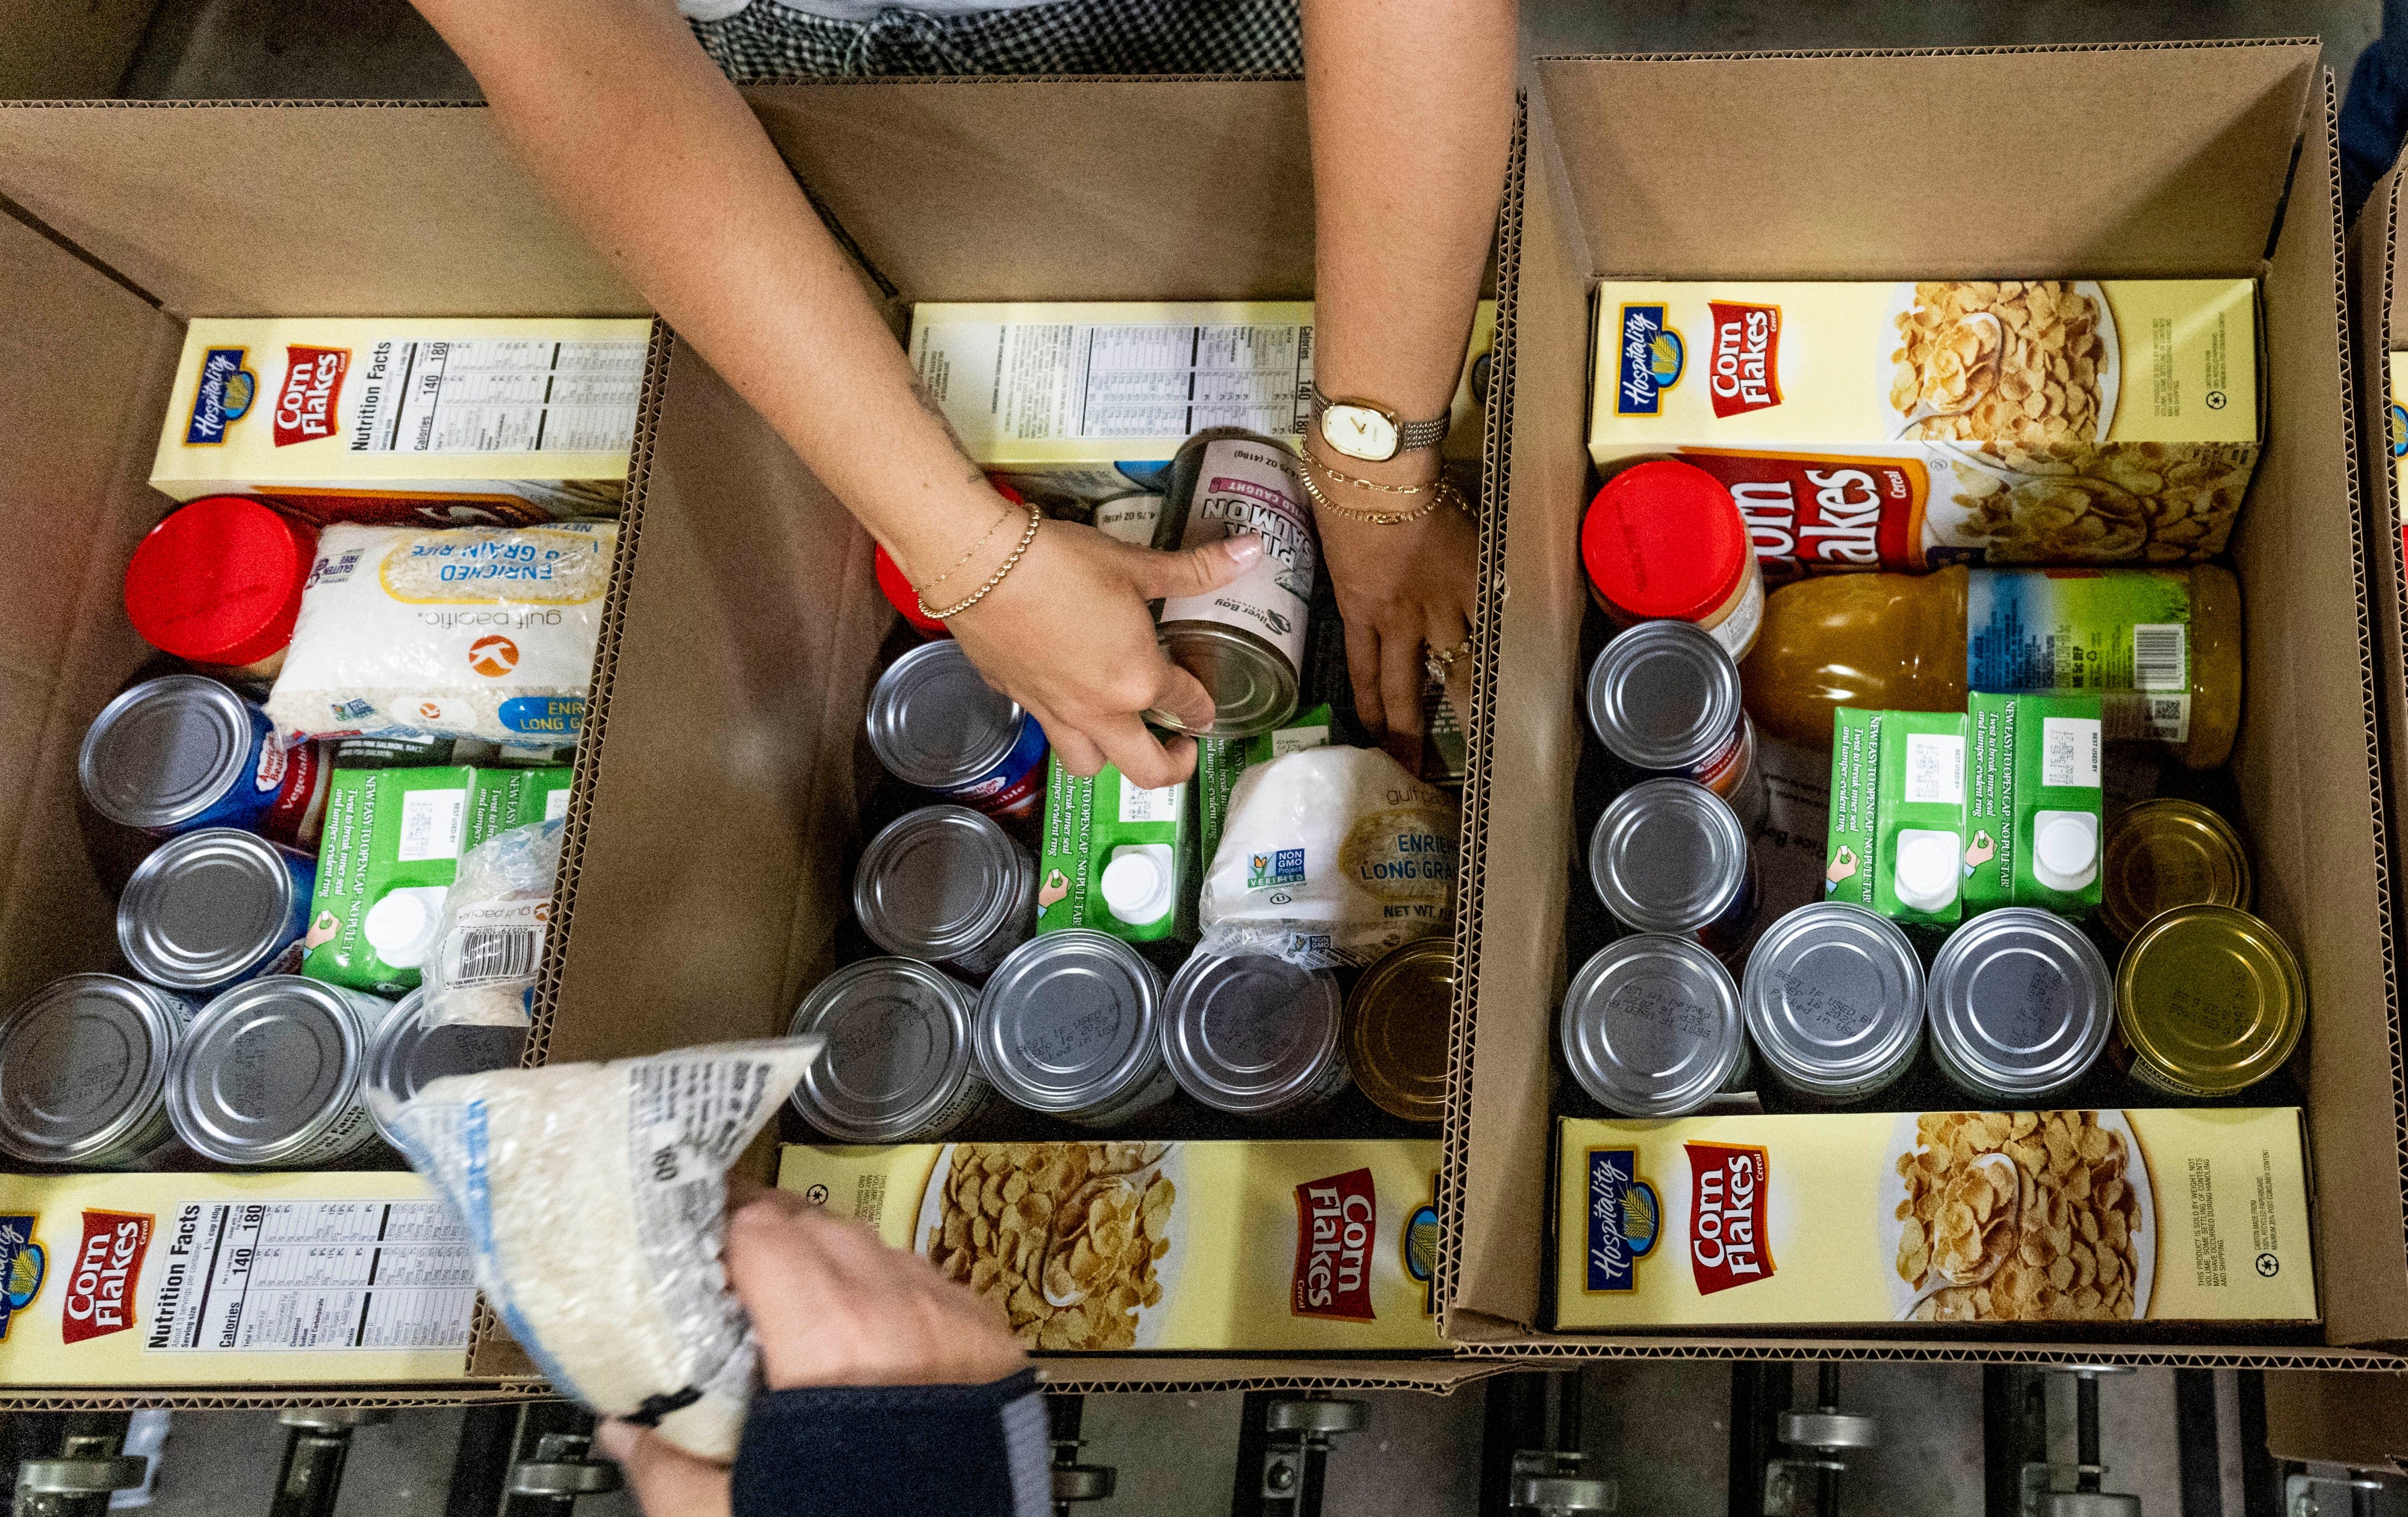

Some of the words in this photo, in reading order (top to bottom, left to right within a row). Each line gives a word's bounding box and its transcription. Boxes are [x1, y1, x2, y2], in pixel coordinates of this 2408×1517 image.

[430, 342, 447, 361] 180
[1300, 326, 1313, 360] Calories
[1622, 312, 1658, 406] Hospitality
[1712, 321, 1742, 398] Corn
[1739, 311, 1770, 405] Flakes
[194, 355, 235, 436] Hospitality
[277, 362, 313, 429] Corn
[302, 353, 337, 435] Flakes
[350, 386, 380, 450] Nutrition
[367, 342, 391, 379] Facts
[423, 375, 439, 395] 140
[1299, 380, 1311, 400] 140
[414, 416, 431, 450] Calories
[1234, 450, 1264, 461] (418g)
[1265, 457, 1278, 467] OZ
[1228, 481, 1279, 503] CAUGHT
[1884, 471, 1907, 499] Cereal
[1202, 498, 1312, 554] SALMON
[462, 542, 536, 561] GRAIN
[440, 564, 553, 582] ENRICHED
[1215, 599, 1240, 612] Bay
[517, 610, 562, 630] gulf
[520, 718, 563, 730] LONG
[1978, 711, 1987, 730] and
[1990, 713, 1999, 736] Twist
[2005, 701, 2015, 725] NEW
[1842, 726, 1852, 745] and
[1854, 728, 1864, 751] Twist
[1870, 716, 1879, 740] NEW
[2004, 727, 2013, 749] EASY
[1989, 737, 1996, 746] to
[1853, 752, 1860, 762] to
[1868, 742, 1878, 765] EASY
[1975, 730, 1986, 798] tamper-evident
[1988, 748, 1998, 773] break
[2003, 751, 2012, 766] TO
[1067, 775, 1075, 783] to
[1839, 746, 1850, 813] tamper-evident
[1852, 763, 1862, 788] break
[1867, 766, 1876, 781] TO
[2002, 767, 2012, 795] OPEN
[366, 775, 376, 800] NEW
[1065, 785, 1076, 810] break
[1082, 788, 1091, 802] TO
[1386, 786, 1419, 805] gulf
[1866, 783, 1876, 813] OPEN
[1987, 774, 1997, 799] inner
[1052, 768, 1063, 836] tamper-evident
[1851, 789, 1861, 813] inner
[1972, 799, 1984, 817] ring
[1987, 799, 1996, 817] seal
[2002, 796, 2011, 816] CAP
[362, 802, 374, 827] EASY
[1064, 811, 1075, 836] inner
[1081, 804, 1091, 832] OPEN
[1835, 814, 1848, 833] ring
[1850, 814, 1859, 832] seal
[1866, 813, 1875, 832] CAP
[361, 829, 371, 843] TO
[2001, 822, 2011, 839] NO
[1047, 837, 1060, 857] ring
[1063, 837, 1072, 855] seal
[1079, 833, 1089, 854] CAP
[1864, 837, 1873, 854] NO
[2001, 839, 2010, 864] PULL
[357, 843, 369, 872] OPEN
[1278, 858, 1302, 867] GMO
[1279, 851, 1302, 860] NON
[1077, 860, 1087, 876] NO
[1361, 860, 1416, 880] LONG
[1863, 855, 1873, 881] PULL
[2000, 865, 2009, 887] TAB!
[353, 873, 365, 894] CAP
[1075, 877, 1085, 902] PULL
[1250, 875, 1302, 886] VERIFIED
[1862, 882, 1872, 903] TAB!
[350, 900, 362, 916] NO
[506, 906, 530, 919] gulf
[1073, 904, 1084, 926] TAB!
[1384, 905, 1410, 918] NET
[344, 918, 358, 943] PULL
[1754, 1154, 1763, 1181] Cereal
[2196, 1158, 2205, 1192] CONTENTS
[2203, 1159, 2212, 1191] HANDLING
[211, 1205, 222, 1222] (40g)
[1724, 1155, 1761, 1276] Flakes
[2192, 1200, 2198, 1209] BY
[1592, 1159, 1629, 1280] Hospitality
[1693, 1168, 1724, 1267] Corn
[2259, 1209, 2268, 1235] RECYCLED
[139, 1220, 149, 1245] Cereal
[208, 1223, 217, 1237] cup
[2208, 1218, 2217, 1255] OCCURRED
[1308, 1186, 1342, 1307] Flakes
[1338, 1194, 1373, 1294] Corn
[67, 1233, 111, 1320] Corn
[95, 1221, 138, 1327] Flakes
[148, 1264, 185, 1348] Nutrition
[170, 1205, 200, 1255] Facts
[181, 1287, 191, 1315] servings
[191, 1243, 202, 1273] container
[219, 1302, 240, 1348] Calories
[232, 1249, 252, 1275] 140
[243, 1205, 262, 1231] 180
[181, 1321, 192, 1348] Serving
